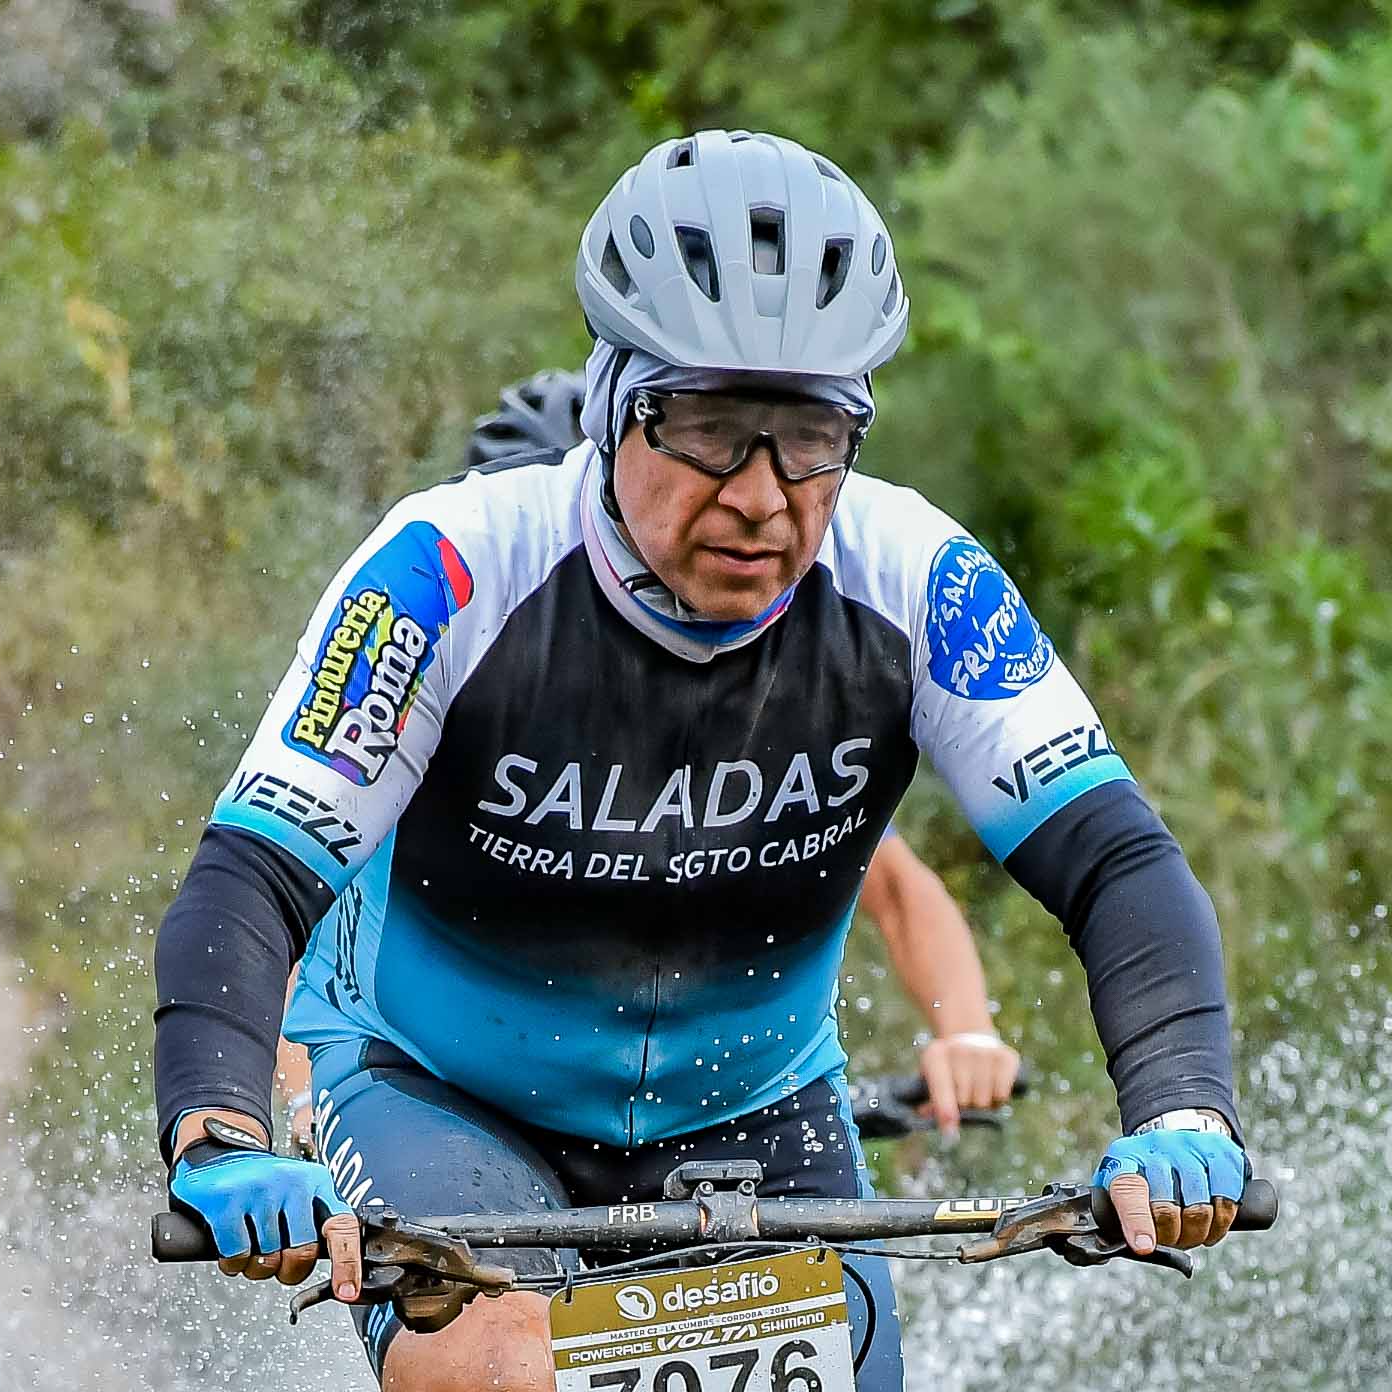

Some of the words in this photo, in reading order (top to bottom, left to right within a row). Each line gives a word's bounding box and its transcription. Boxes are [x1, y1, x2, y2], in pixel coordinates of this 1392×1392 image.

[327, 615, 427, 784] Roma
[478, 737, 872, 833] SALADAS
[469, 823, 573, 880] TIERRA
[584, 853, 650, 882] DEL
[666, 846, 751, 884] SGTO
[759, 807, 867, 868] CABRAL
[569, 1341, 655, 1364] POWERADE
[658, 1323, 758, 1352] VOLTA
[761, 1312, 825, 1334] SHIMANO
[610, 1329, 645, 1341] MASTER
[665, 1324, 676, 1333] LA
